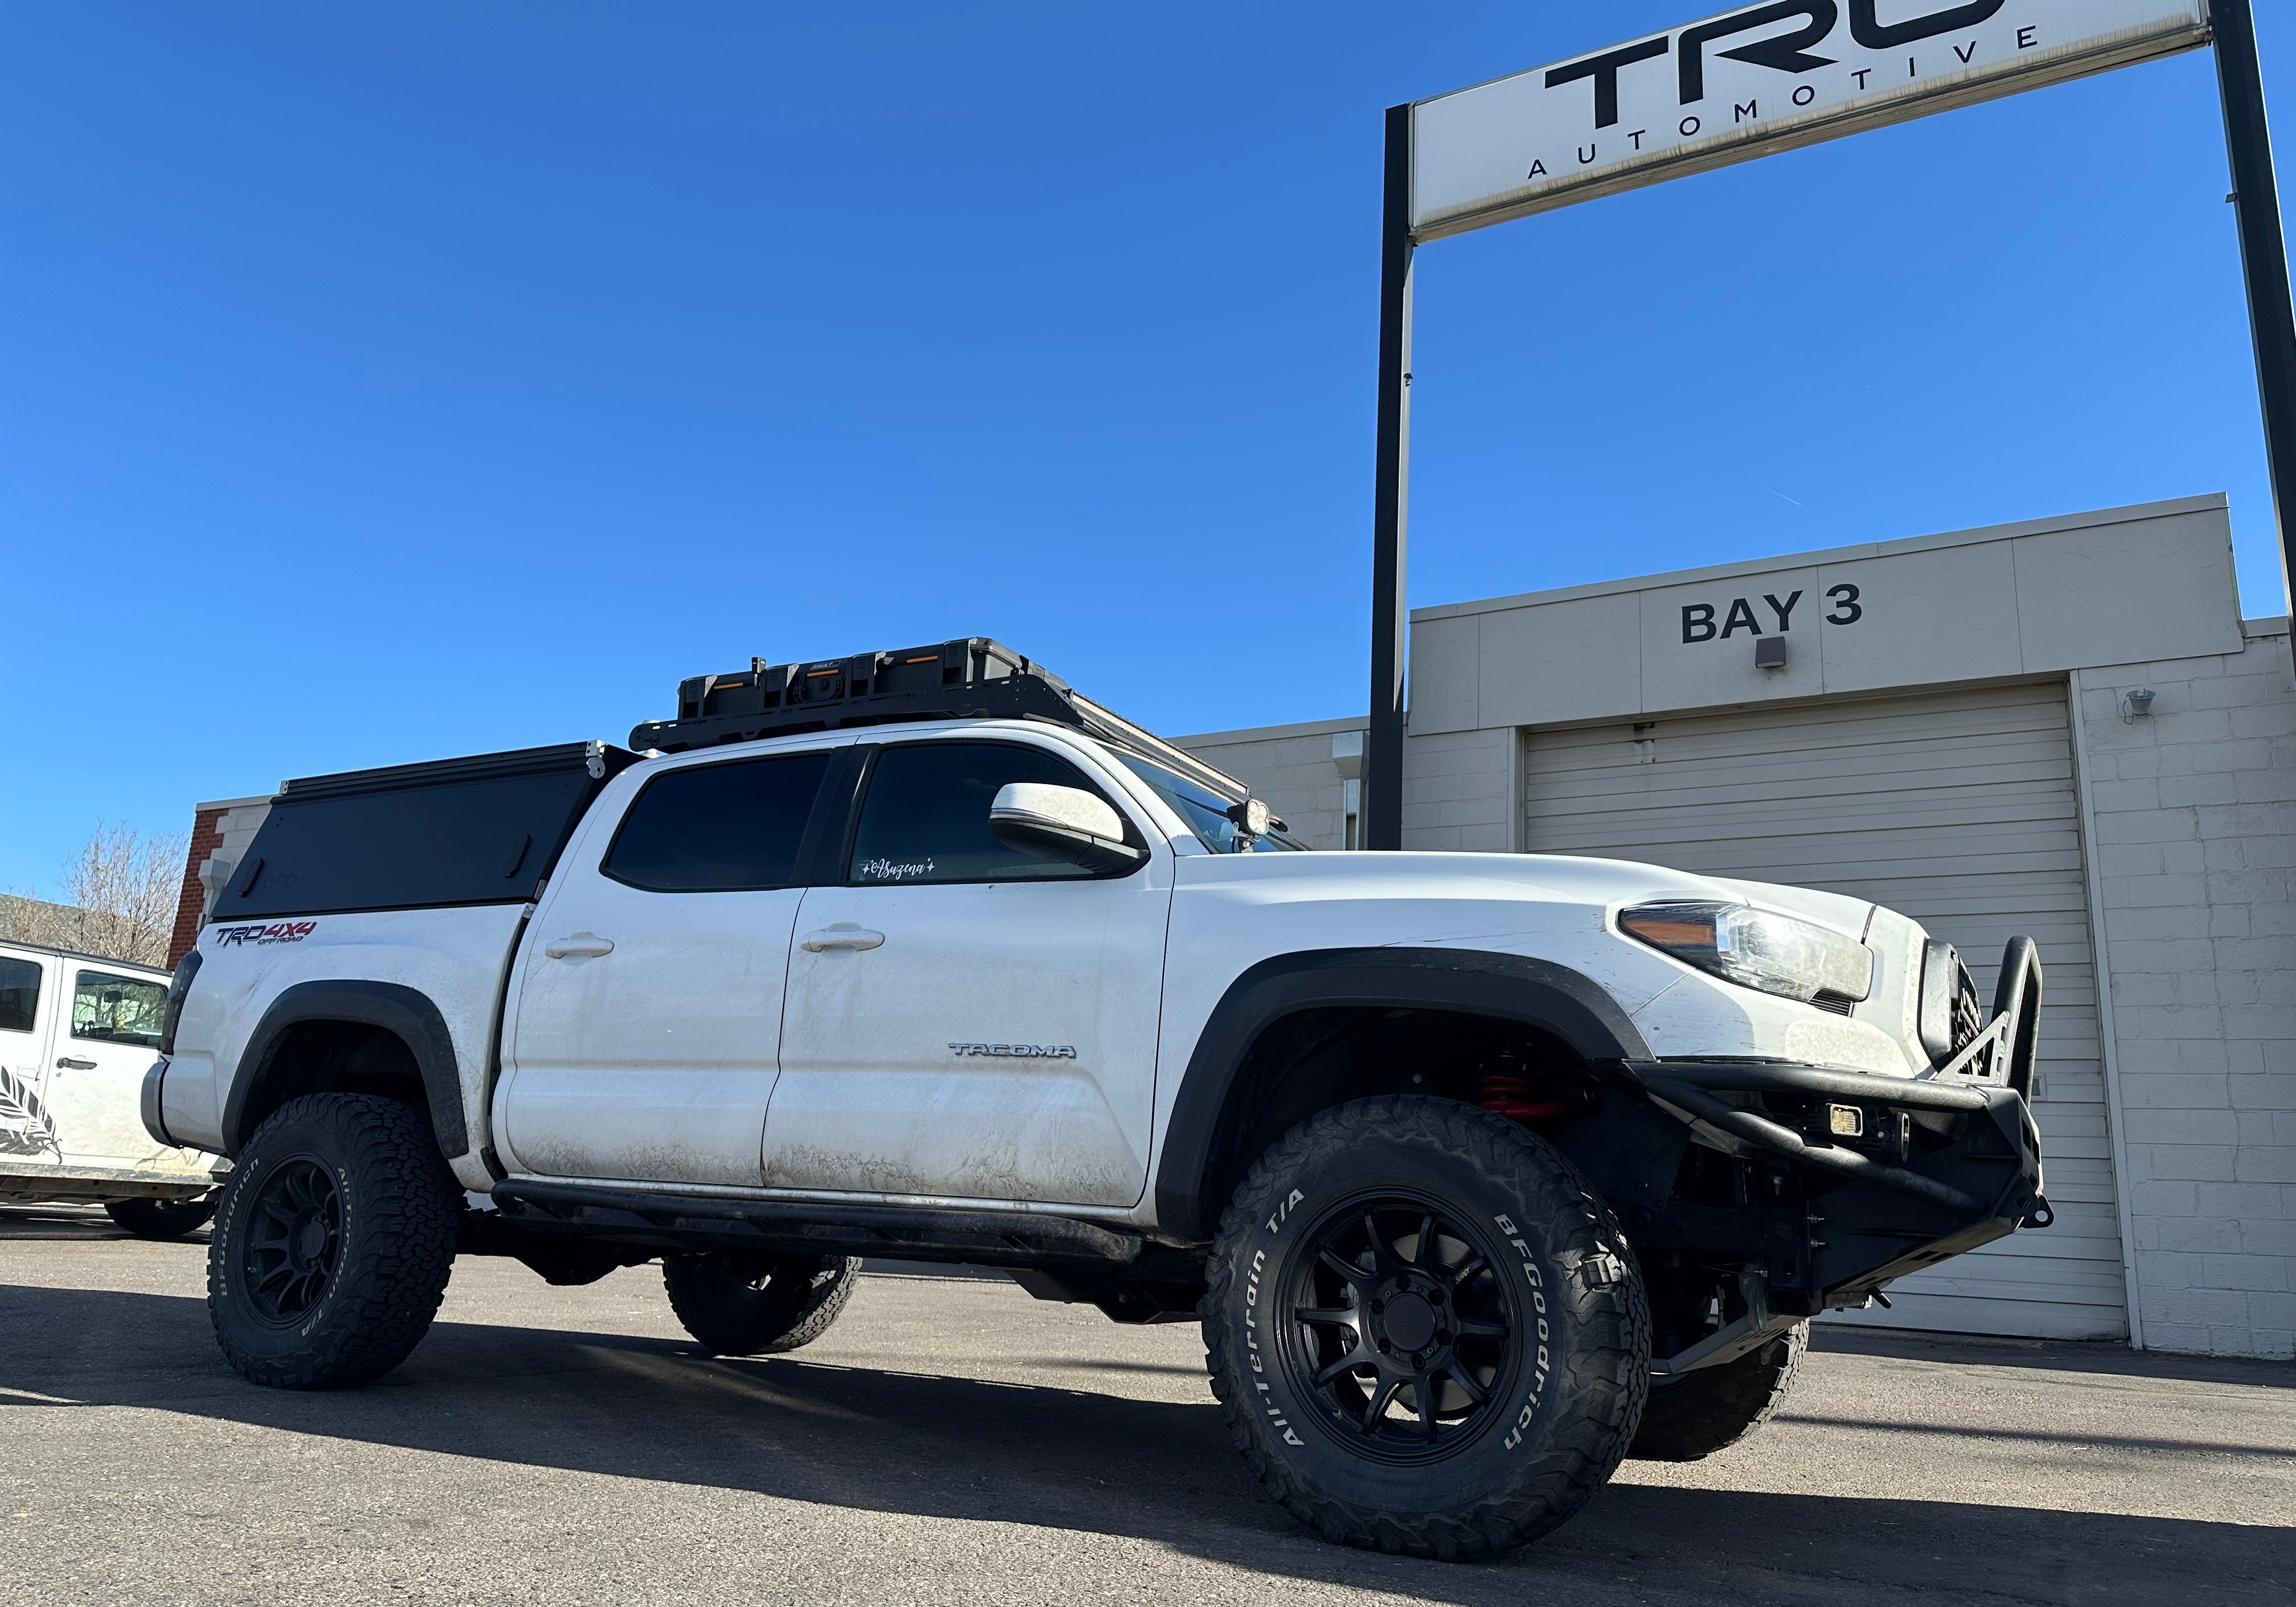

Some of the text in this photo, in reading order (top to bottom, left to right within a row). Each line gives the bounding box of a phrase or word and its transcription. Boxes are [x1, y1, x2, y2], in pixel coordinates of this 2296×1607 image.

[1527, 25, 2038, 179] AUTOMOTIVE
[1681, 583, 1863, 644] BAY 3
[948, 1043, 1076, 1059] TACOMA
[1240, 1188, 1306, 1448] All-Terrain T/A
[1493, 1213, 1551, 1450] BFGoodrich
